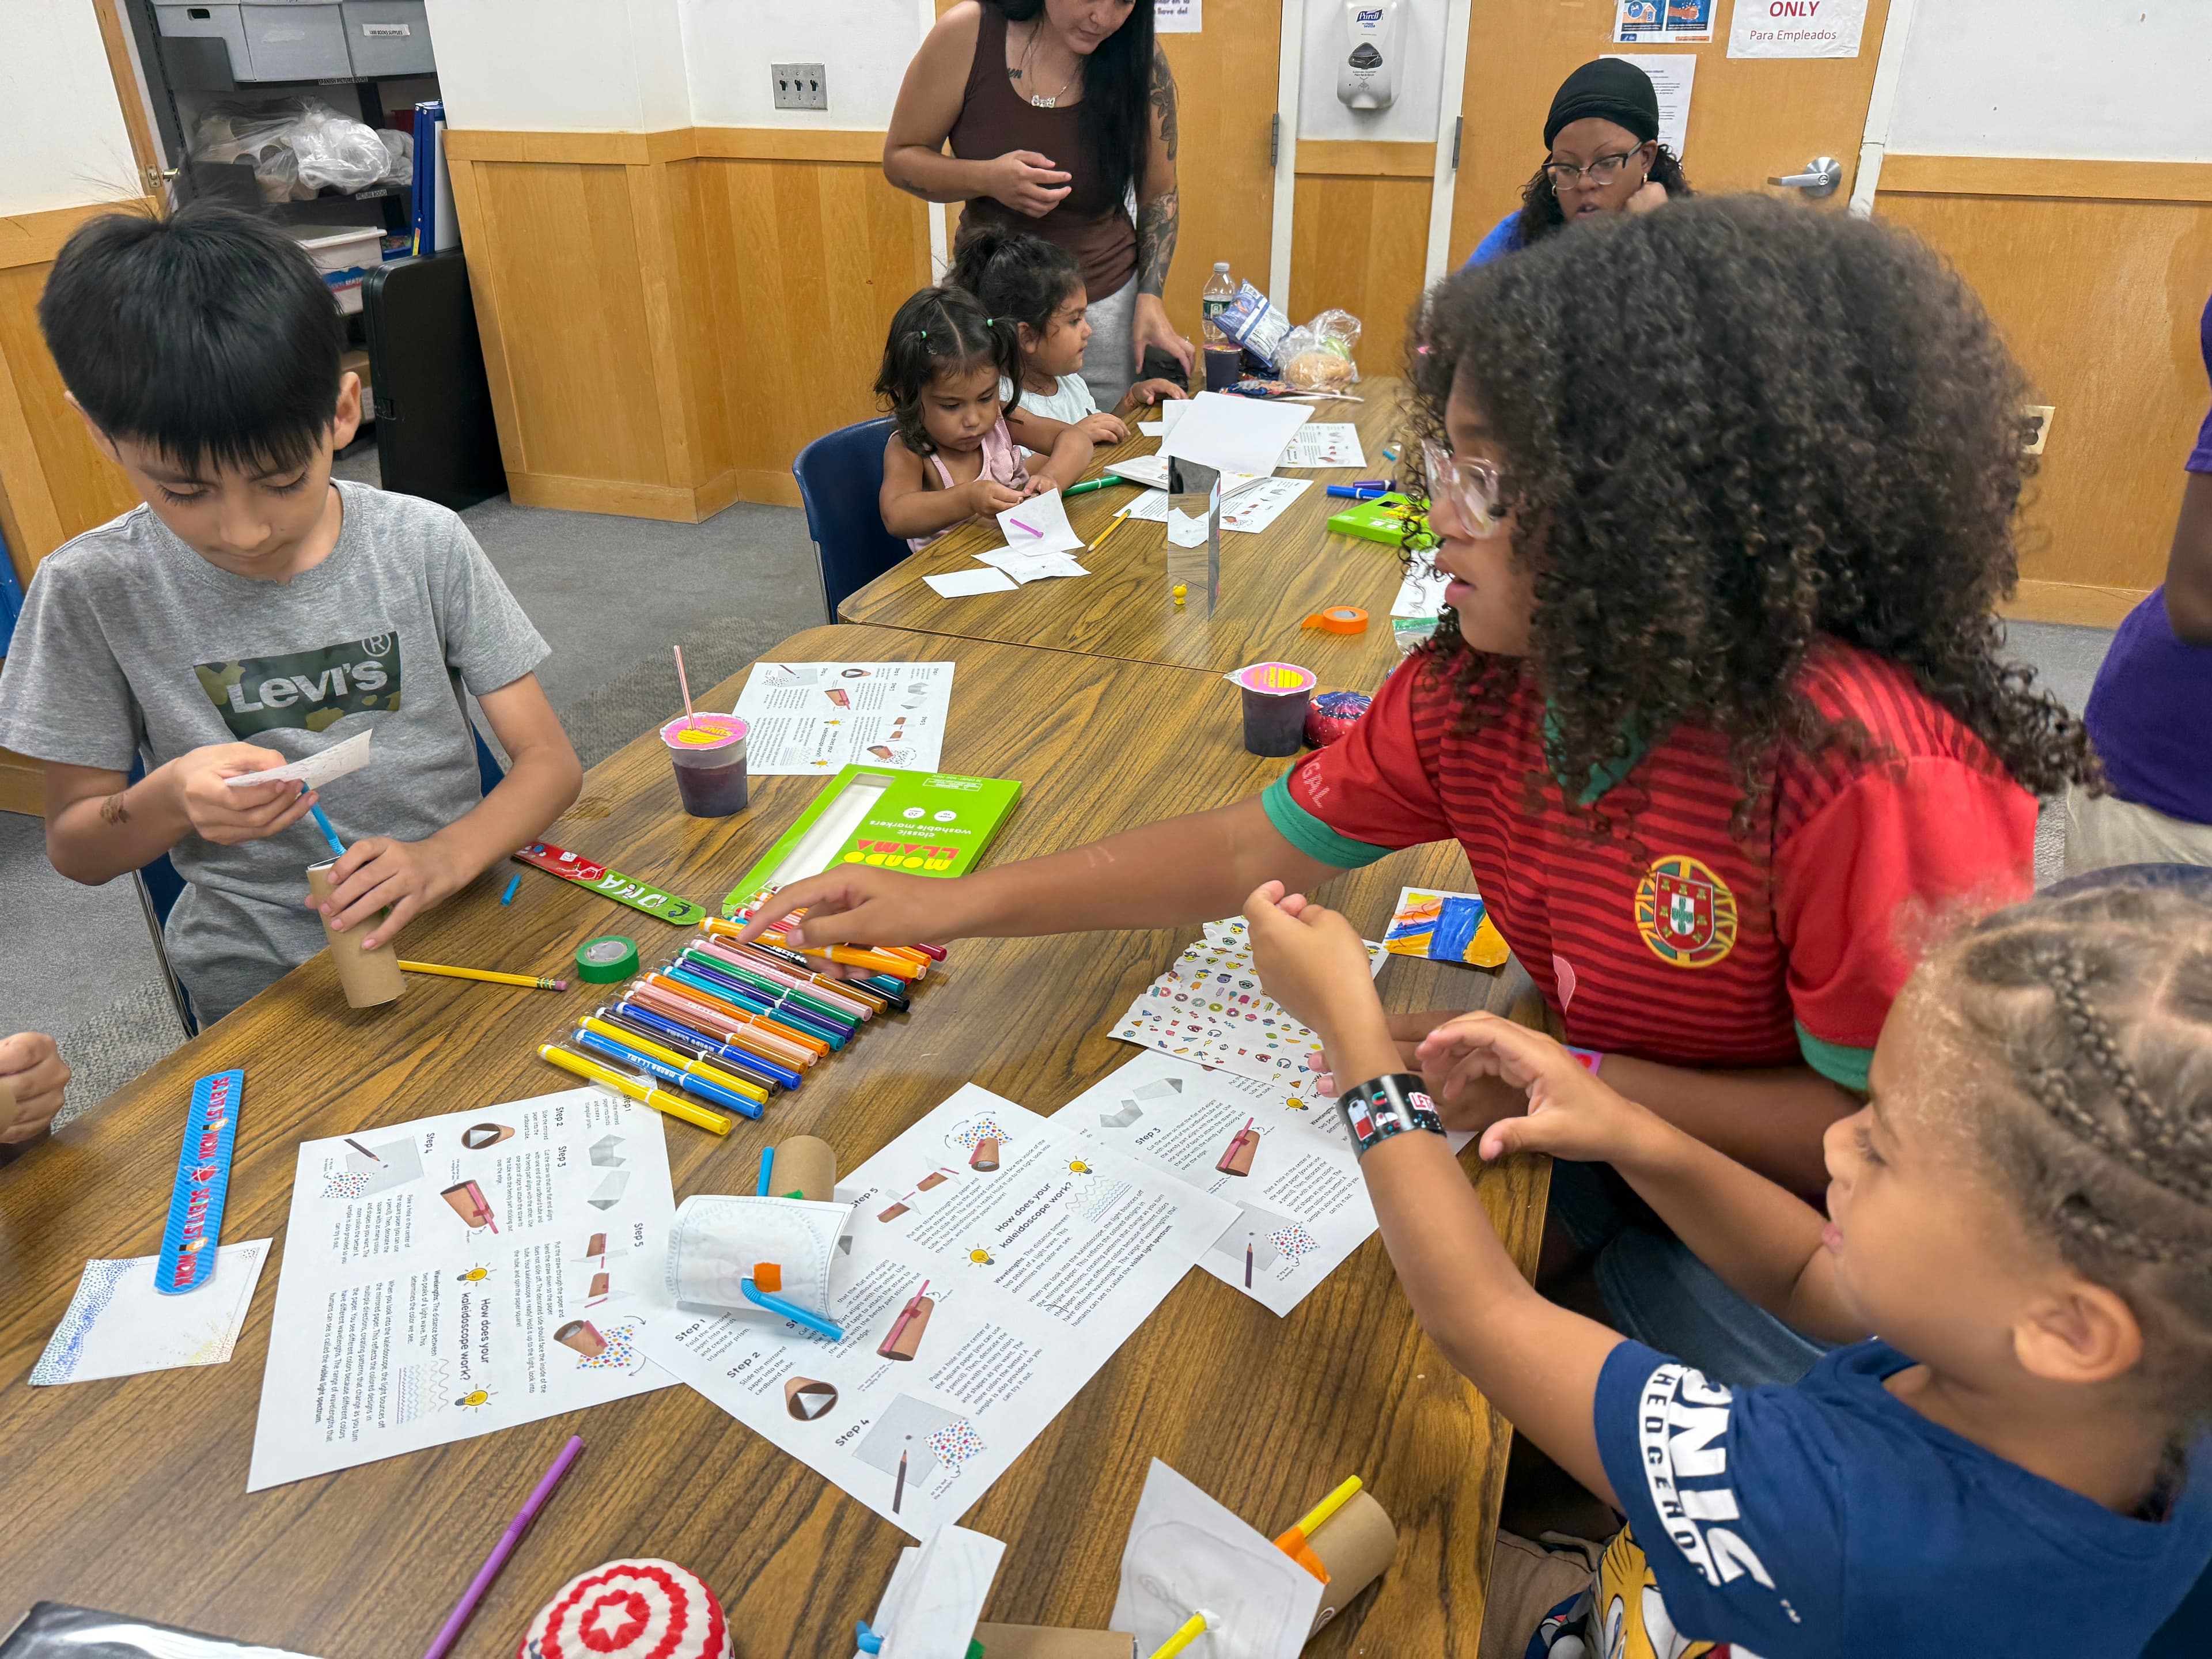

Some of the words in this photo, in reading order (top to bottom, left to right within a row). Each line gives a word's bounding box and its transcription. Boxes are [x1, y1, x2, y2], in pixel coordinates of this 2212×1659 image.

[1770, 1, 1820, 17] ONLY
[1749, 30, 1773, 40] Para
[1777, 29, 1837, 41] Empleados
[226, 661, 388, 713] Levi's
[869, 820, 916, 830] markers
[897, 830, 935, 838] classic
[917, 825, 972, 835] washable
[844, 851, 952, 871] MONDO
[857, 839, 959, 859] LLAMA
[554, 1107, 564, 1121] Step
[424, 1132, 435, 1148] Step
[1135, 1131, 1154, 1145] Step
[557, 1146, 567, 1161] Step
[994, 1215, 1015, 1232] How
[1014, 1199, 1035, 1216] does
[1032, 1183, 1051, 1200] your
[998, 1203, 1050, 1248] kaleidoscope
[1048, 1181, 1073, 1203] work?
[633, 1222, 643, 1240] Step
[1033, 1231, 1052, 1248] distance
[1050, 1214, 1070, 1232] between
[1086, 1254, 1105, 1272] creating
[1103, 1238, 1121, 1255] patterns
[1119, 1229, 1130, 1238] that
[1128, 1215, 1144, 1229] change
[1147, 1202, 1157, 1211] you
[1154, 1194, 1165, 1203] turn
[1002, 1279, 1014, 1289] two
[1012, 1267, 1027, 1281] peaks
[1033, 1248, 1047, 1259] light
[1044, 1237, 1059, 1248] wave.
[1056, 1228, 1068, 1236] This
[1027, 1290, 1043, 1302] When
[1041, 1281, 1052, 1290] you
[1049, 1271, 1062, 1281] look
[1059, 1263, 1071, 1272] into
[1069, 1255, 1078, 1263] the
[1110, 1211, 1123, 1222] light
[1119, 1196, 1138, 1213] bounces
[1036, 1299, 1047, 1307] the
[1045, 1280, 1065, 1300] mirrored
[1075, 1258, 1088, 1267] This
[1086, 1243, 1104, 1258] reflects
[1109, 1220, 1126, 1236] colored
[1124, 1206, 1141, 1221] designs
[1054, 1306, 1065, 1317] the
[1074, 1286, 1086, 1294] You
[1085, 1278, 1095, 1286] see
[1093, 1260, 1113, 1278] different
[1111, 1248, 1125, 1260] colors
[1122, 1231, 1141, 1248] because
[1139, 1214, 1158, 1232] different
[1156, 1202, 1169, 1214] colors
[1012, 1270, 1037, 1293] determines
[1035, 1262, 1045, 1270] the
[1044, 1251, 1056, 1262] color
[480, 1298, 491, 1317] How
[459, 1292, 471, 1350] kaleidoscope
[480, 1320, 491, 1342] does
[675, 1323, 700, 1341] Step
[685, 1336, 699, 1347] Fold
[698, 1330, 709, 1338] the
[709, 1311, 732, 1331] mirrored
[692, 1339, 709, 1353] paper
[707, 1330, 721, 1339] into
[719, 1318, 737, 1331] thirds
[700, 1347, 711, 1357] and
[711, 1334, 728, 1349] create
[706, 1340, 733, 1361] triangular
[733, 1328, 751, 1342] prism.
[460, 1351, 471, 1380] work?
[479, 1342, 489, 1363] your
[739, 1373, 755, 1385] Slide
[753, 1365, 764, 1374] the
[763, 1346, 786, 1366] mirrored
[726, 1358, 752, 1378] Step
[747, 1377, 763, 1391] paper
[762, 1368, 775, 1377] into
[774, 1359, 785, 1368] the
[755, 1372, 782, 1395] cardboard
[780, 1362, 796, 1373] tube.
[835, 1425, 860, 1446] Step
[1668, 1368, 1777, 1590] ONIC
